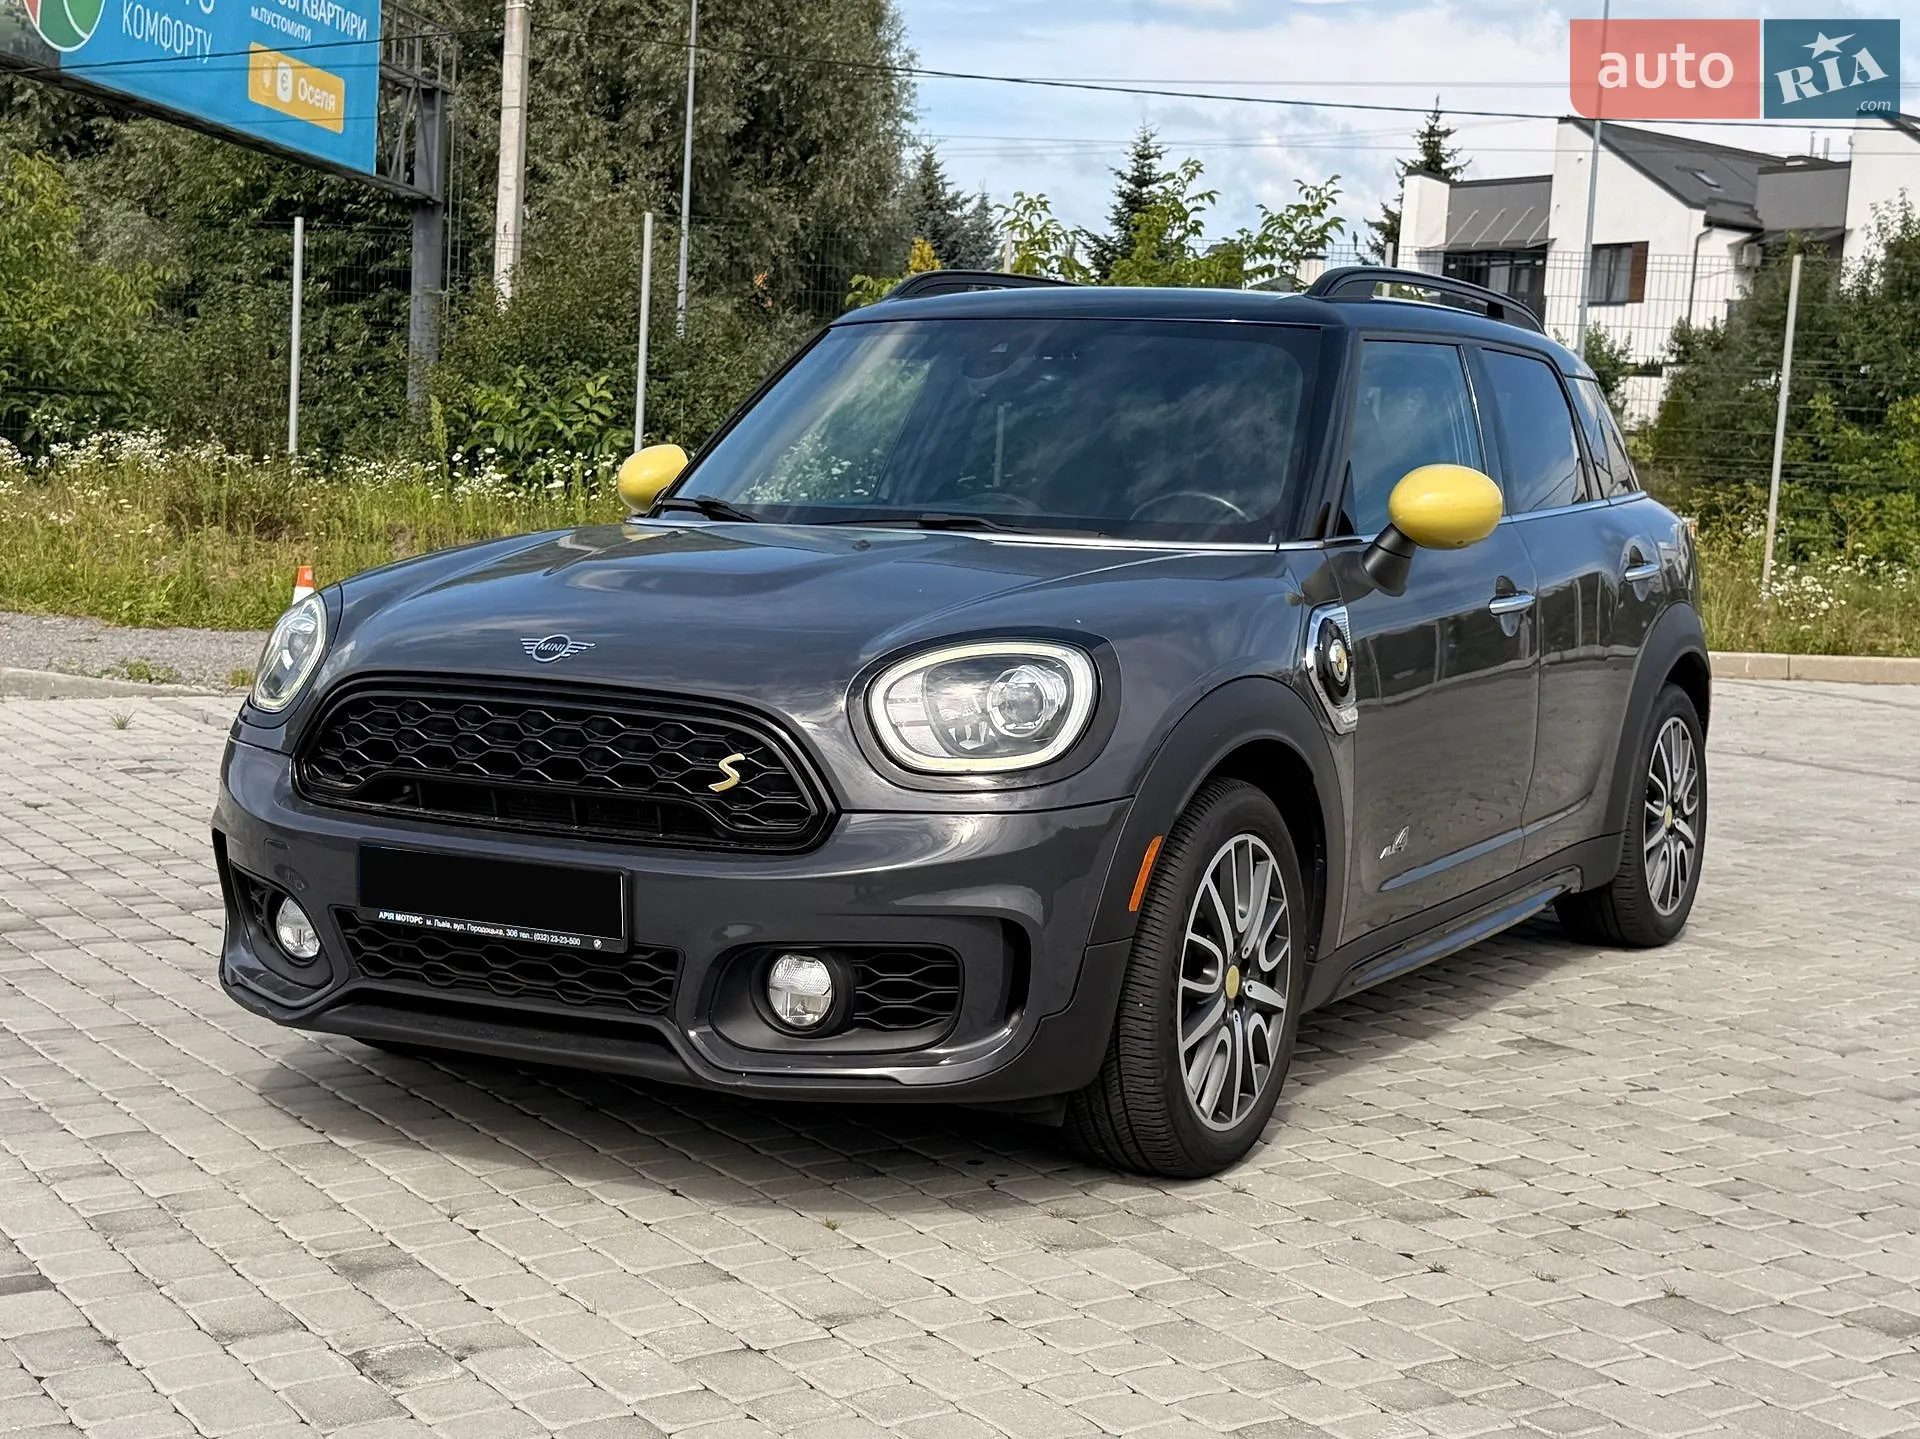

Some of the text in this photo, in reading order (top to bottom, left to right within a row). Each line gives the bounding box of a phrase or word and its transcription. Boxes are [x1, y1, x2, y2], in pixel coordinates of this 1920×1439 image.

[122, 0, 213, 64] КОМФОРТУ
[302, 0, 367, 41] КВАРТИРИ
[298, 77, 336, 113] Оселя
[538, 642, 566, 652] MINI
[708, 752, 745, 792] S
[395, 913, 423, 925] МОТОРС
